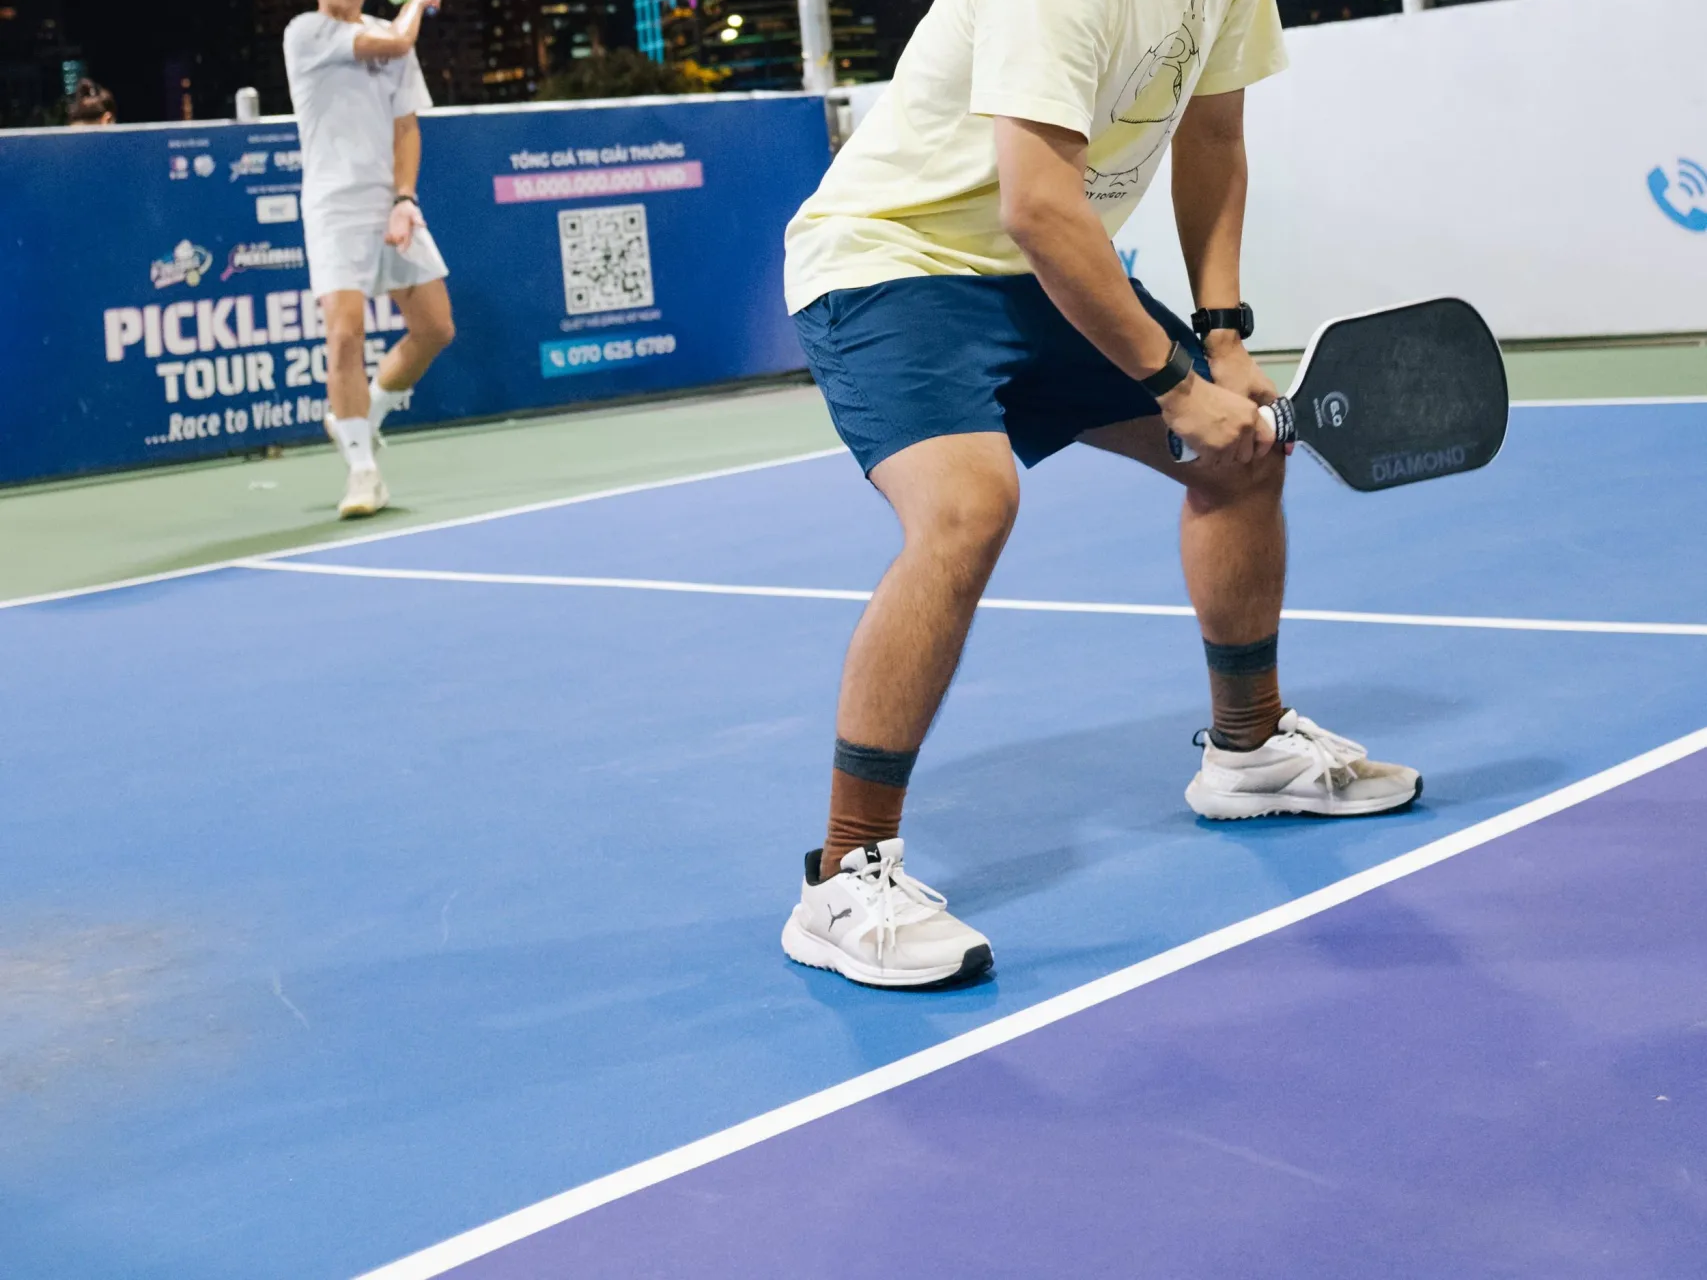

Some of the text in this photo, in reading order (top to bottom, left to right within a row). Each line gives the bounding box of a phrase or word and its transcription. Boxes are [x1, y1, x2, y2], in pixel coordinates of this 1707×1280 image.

[103, 289, 405, 363] PICKLEBL
[155, 338, 387, 403] TOUR 205
[224, 407, 249, 434] to
[251, 399, 294, 431] Viet
[1371, 444, 1466, 484] DIAMOND
